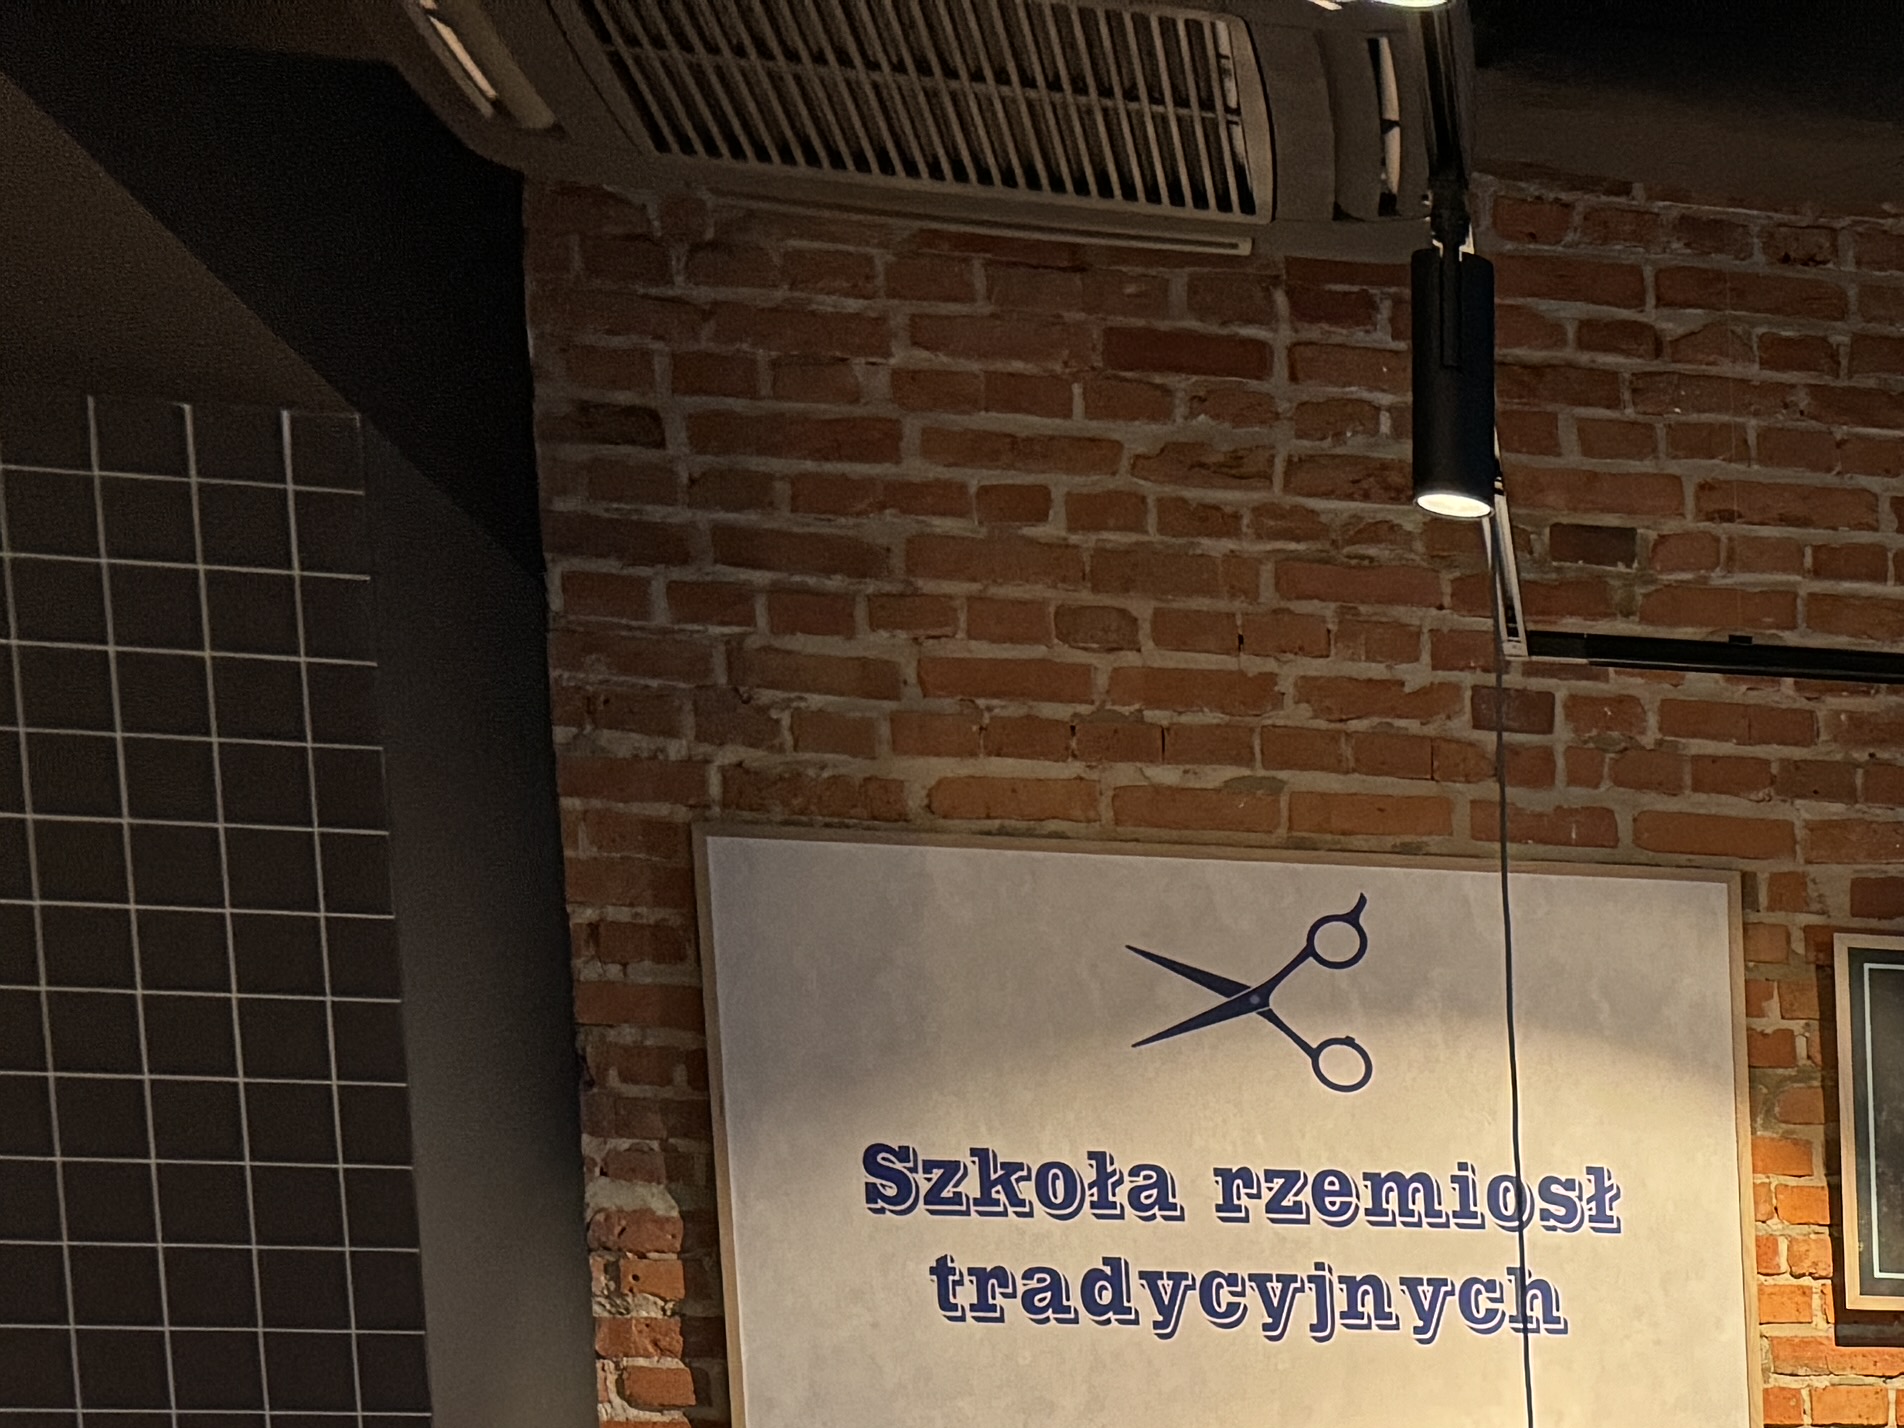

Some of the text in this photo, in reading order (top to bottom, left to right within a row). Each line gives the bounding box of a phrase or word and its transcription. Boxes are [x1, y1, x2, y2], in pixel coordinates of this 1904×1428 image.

[861, 1141, 1625, 1235] Szkoła rzemiosł
[928, 1252, 1569, 1345] tradycyjnych
